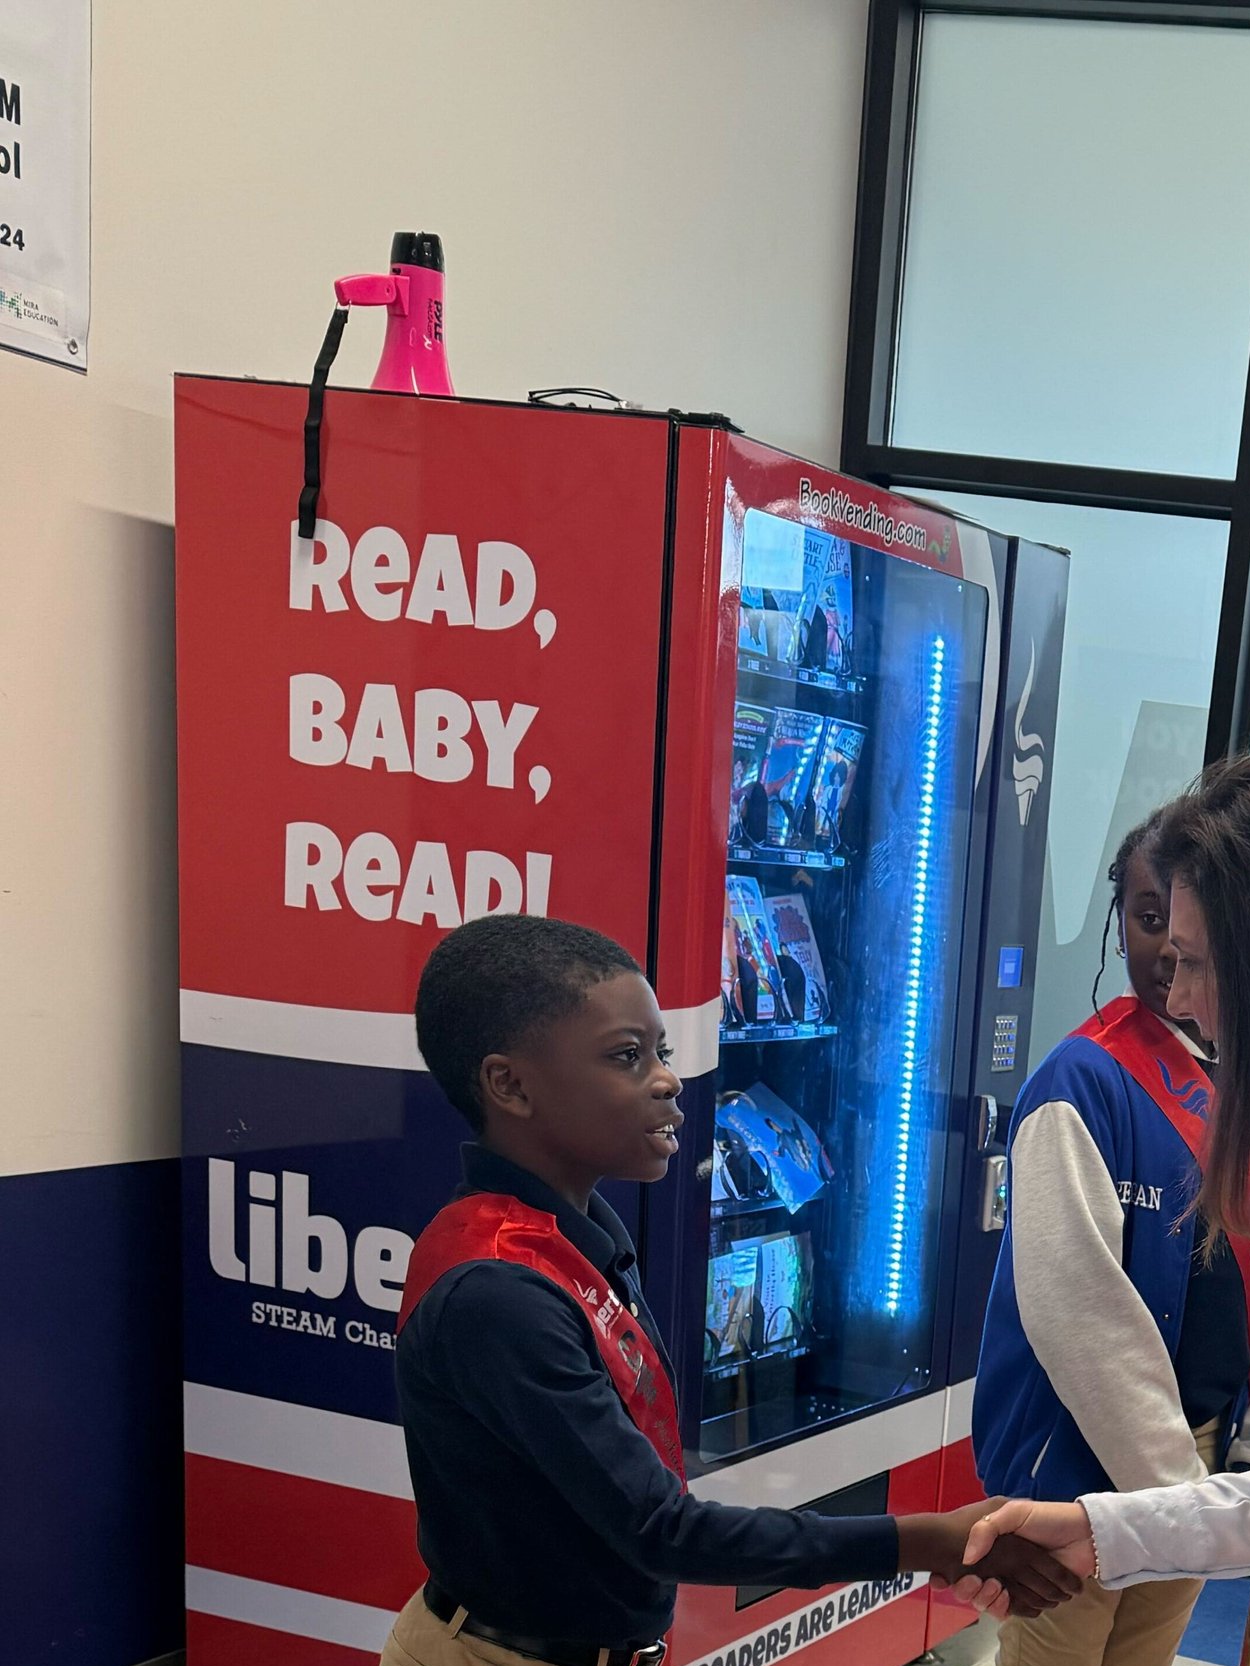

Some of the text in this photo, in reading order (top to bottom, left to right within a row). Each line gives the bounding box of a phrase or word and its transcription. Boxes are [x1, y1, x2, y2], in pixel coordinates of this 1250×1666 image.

[23, 308, 59, 327] EDUCATION
[800, 478, 927, 551] BookVending.com
[289, 672, 552, 805] BABY,
[208, 1157, 416, 1314] libe
[252, 1301, 336, 1339] STEAM
[794, 1606, 836, 1648] ARE
